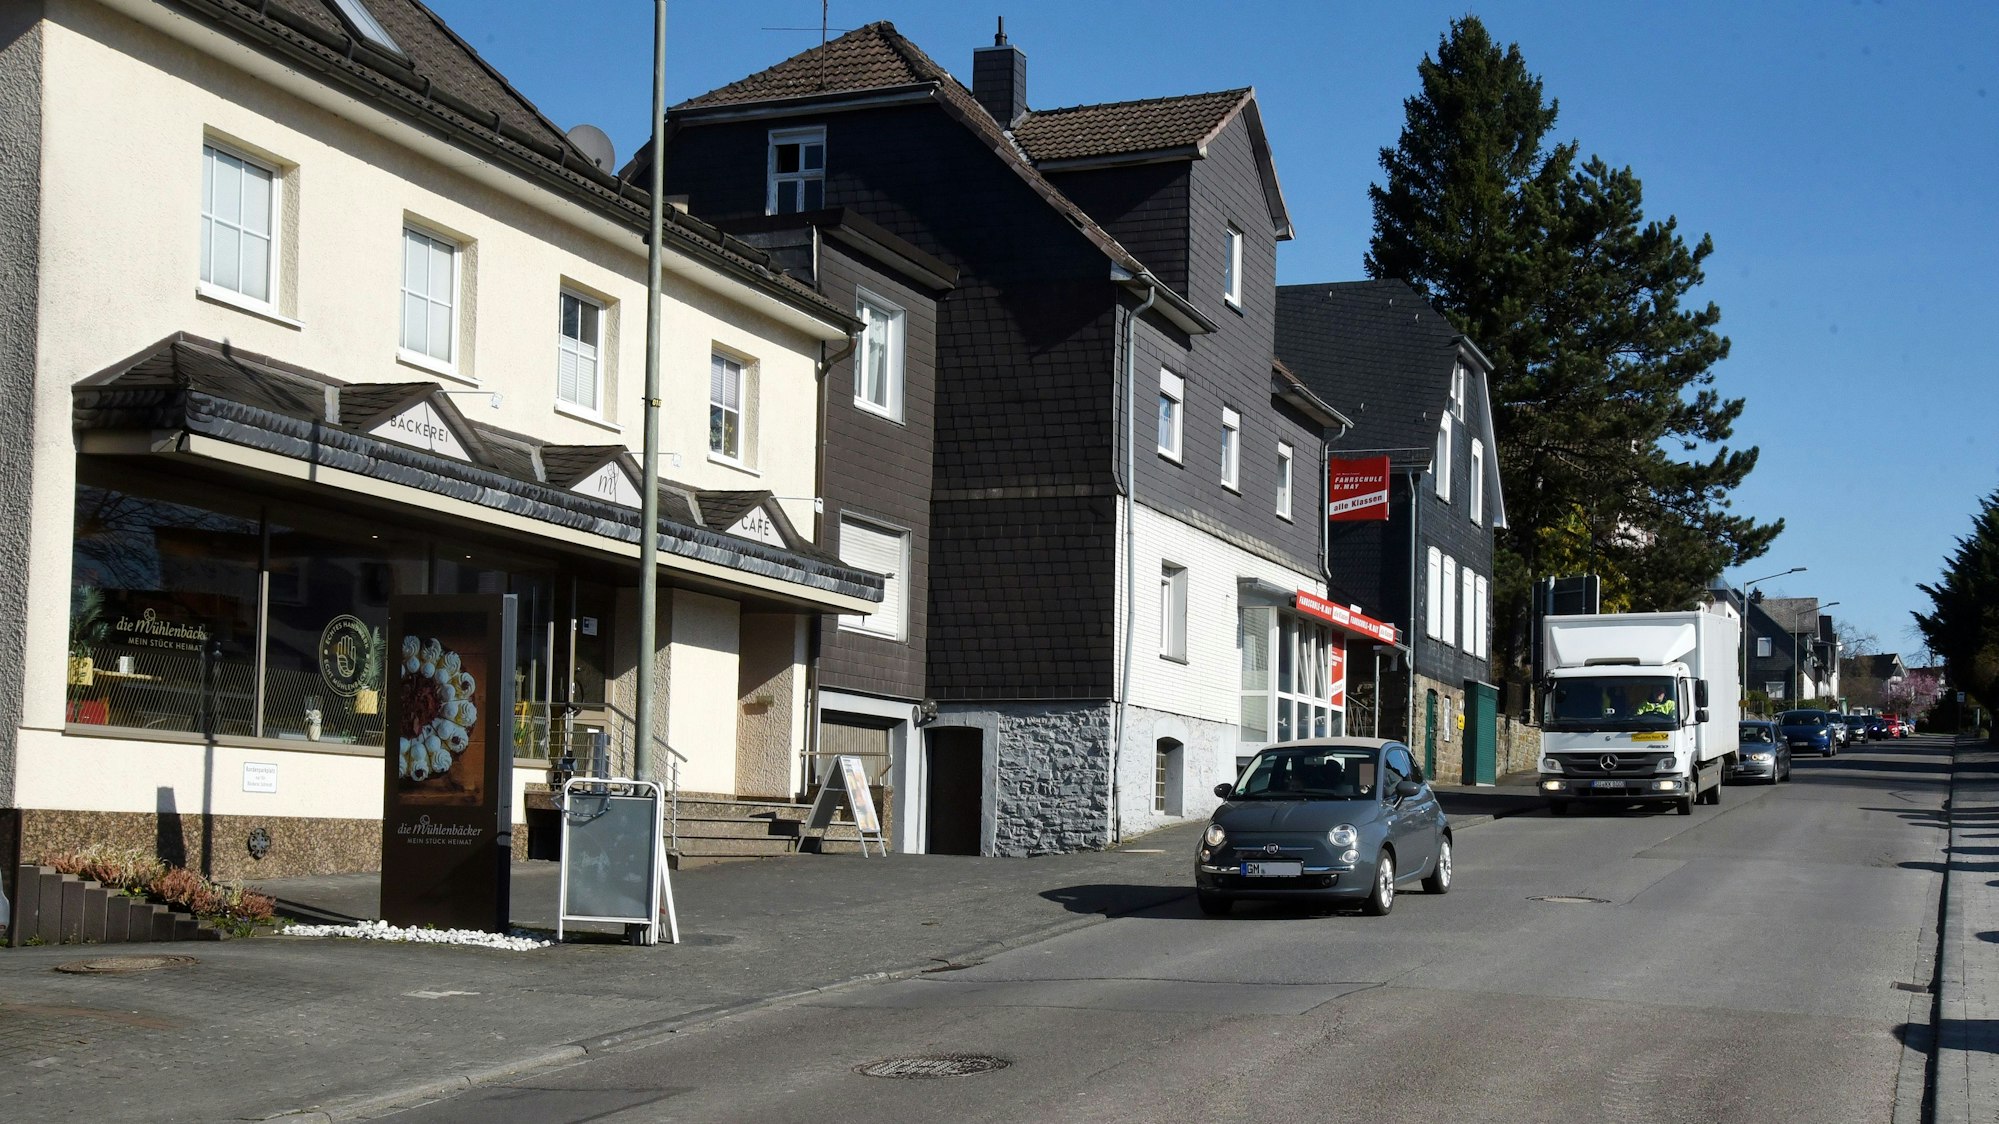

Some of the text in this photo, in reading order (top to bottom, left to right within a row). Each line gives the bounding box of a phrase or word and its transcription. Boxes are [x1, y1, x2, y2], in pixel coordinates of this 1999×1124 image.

[390, 413, 449, 443] BÄCKEREI
[1334, 475, 1383, 483] FAHRSCHULE
[1333, 495, 1383, 512] alle Klassen
[116, 616, 134, 632] die
[325, 621, 343, 645] ECHTES
[128, 636, 203, 652] MEIN STÜCK HEIMAT
[323, 659, 334, 679] ECHT
[397, 815, 483, 836] die Mühlenbäcker
[425, 836, 446, 845] STÜCK
[1247, 863, 1260, 874] GM
